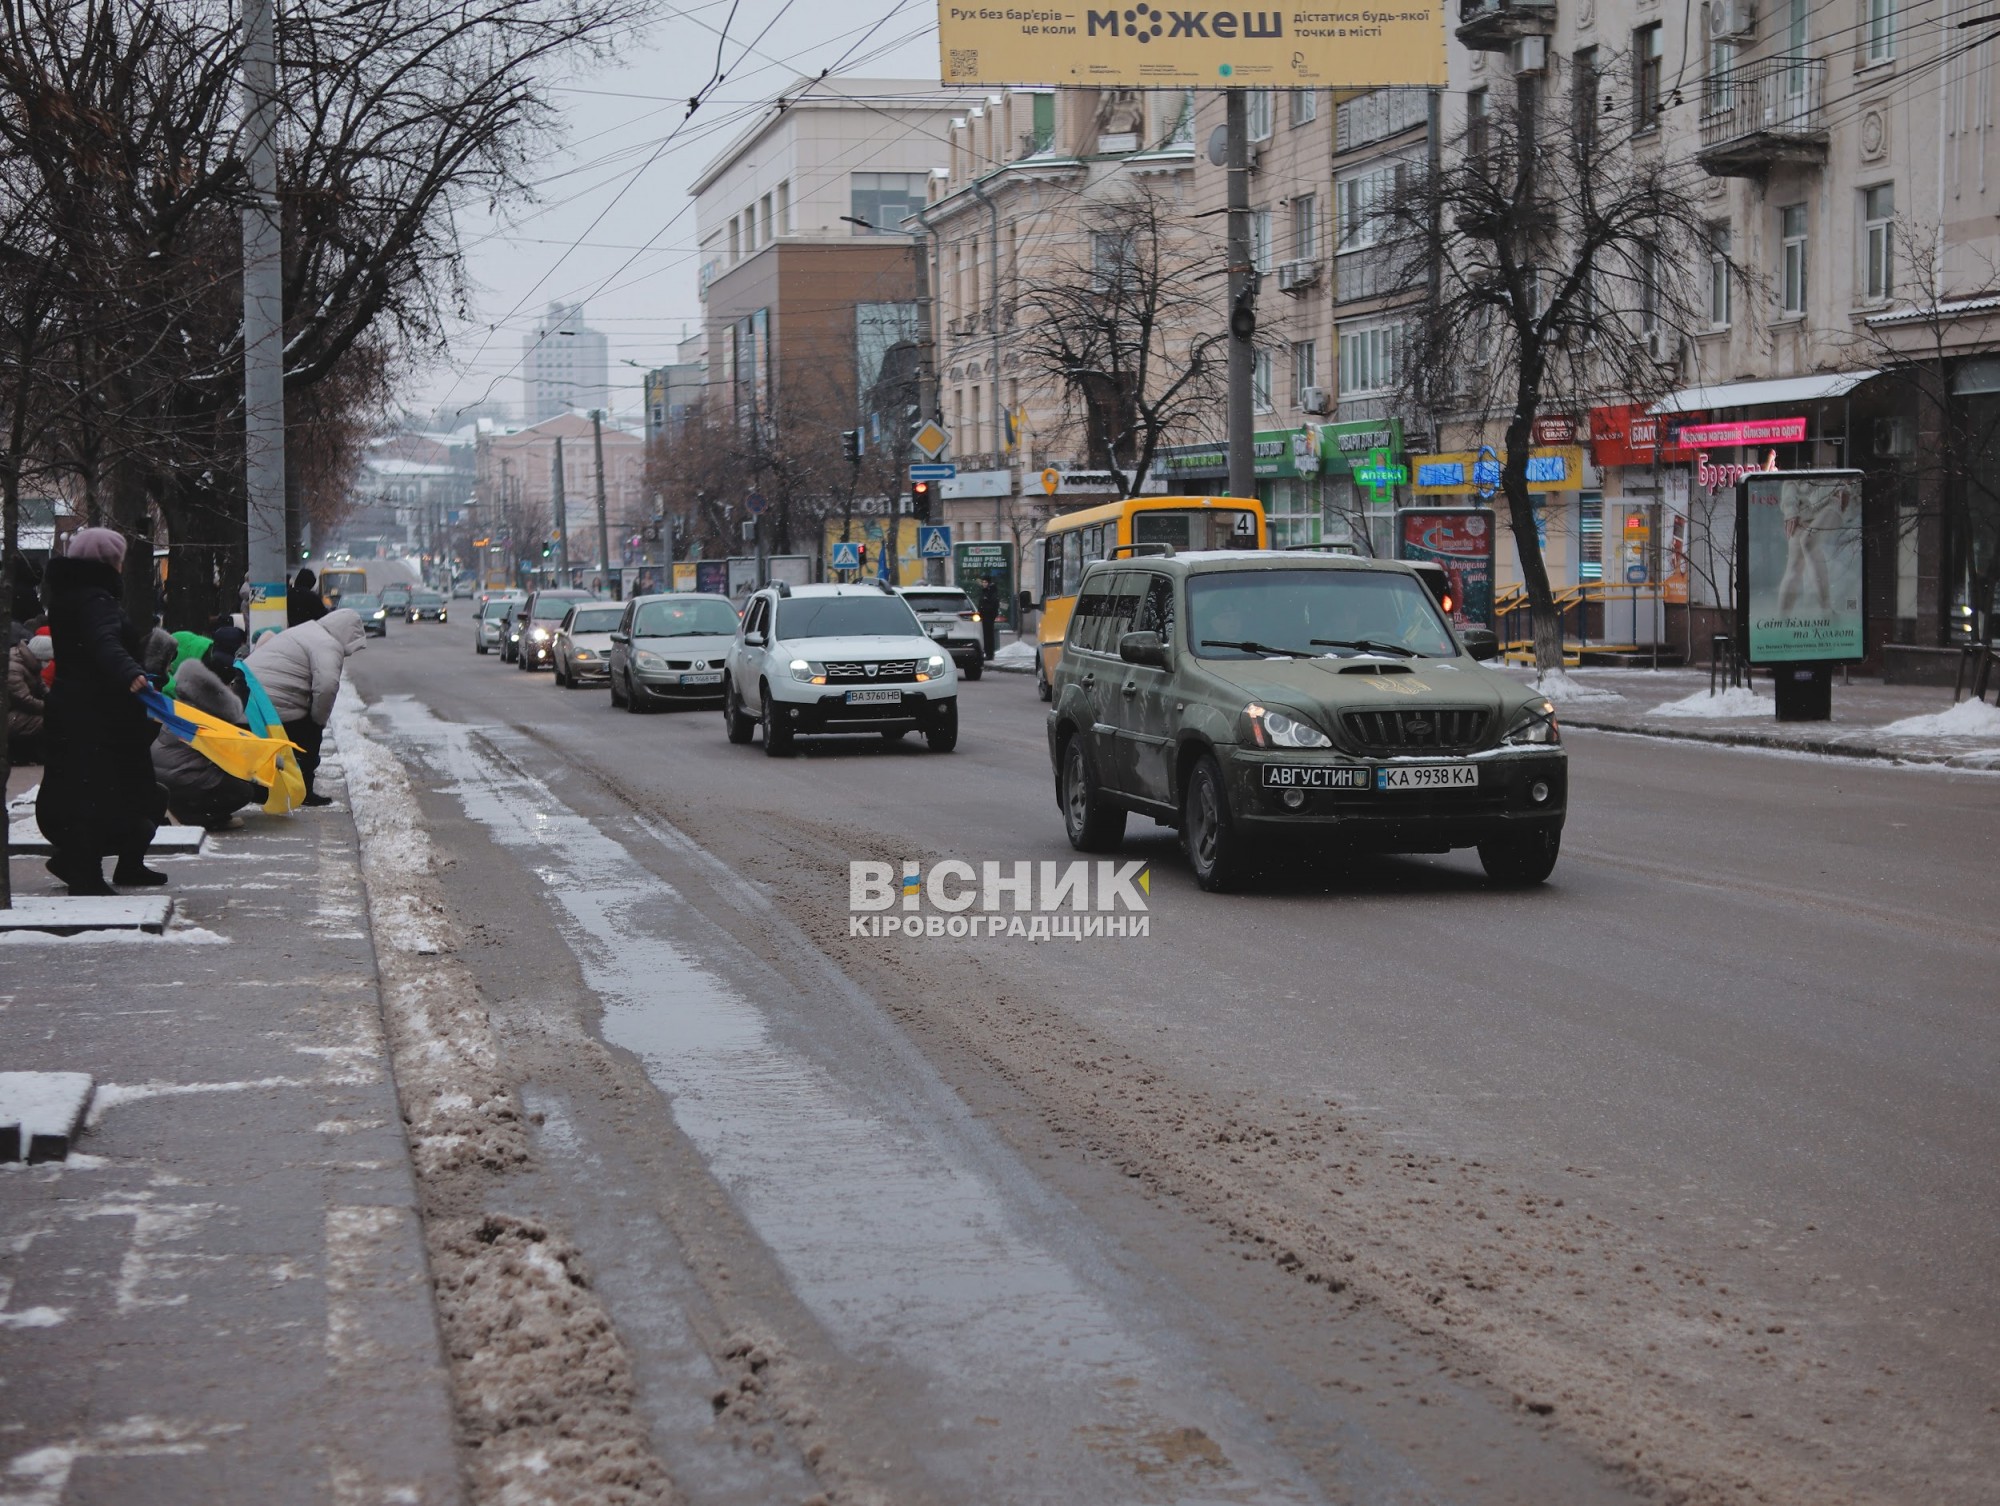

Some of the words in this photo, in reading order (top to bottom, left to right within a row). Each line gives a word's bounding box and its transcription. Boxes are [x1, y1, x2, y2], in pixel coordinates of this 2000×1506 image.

[951, 8, 976, 20] Рух
[979, 9, 1003, 20] без
[1006, 9, 1062, 22] бар'єрів
[1294, 11, 1359, 23] дістатися
[1363, 10, 1430, 23] будь-якої
[1022, 25, 1039, 35] це
[1042, 25, 1076, 34] коли
[1294, 28, 1335, 37] точки
[1339, 28, 1347, 36] в
[1350, 25, 1382, 37] місті
[1709, 427, 1741, 441] магазинів
[1743, 424, 1771, 439] білизни
[1772, 427, 1781, 437] та
[1782, 423, 1803, 439] одягу
[1361, 471, 1402, 480] АПТЕКА
[1237, 514, 1249, 534] 4
[1757, 618, 1783, 631] Світ
[1786, 617, 1831, 629] Білизни
[1793, 631, 1809, 640] та
[1814, 627, 1854, 640] Колгот
[866, 692, 886, 701] 3760
[1269, 768, 1353, 786] АВГУСТИН
[1415, 769, 1450, 785] 9938
